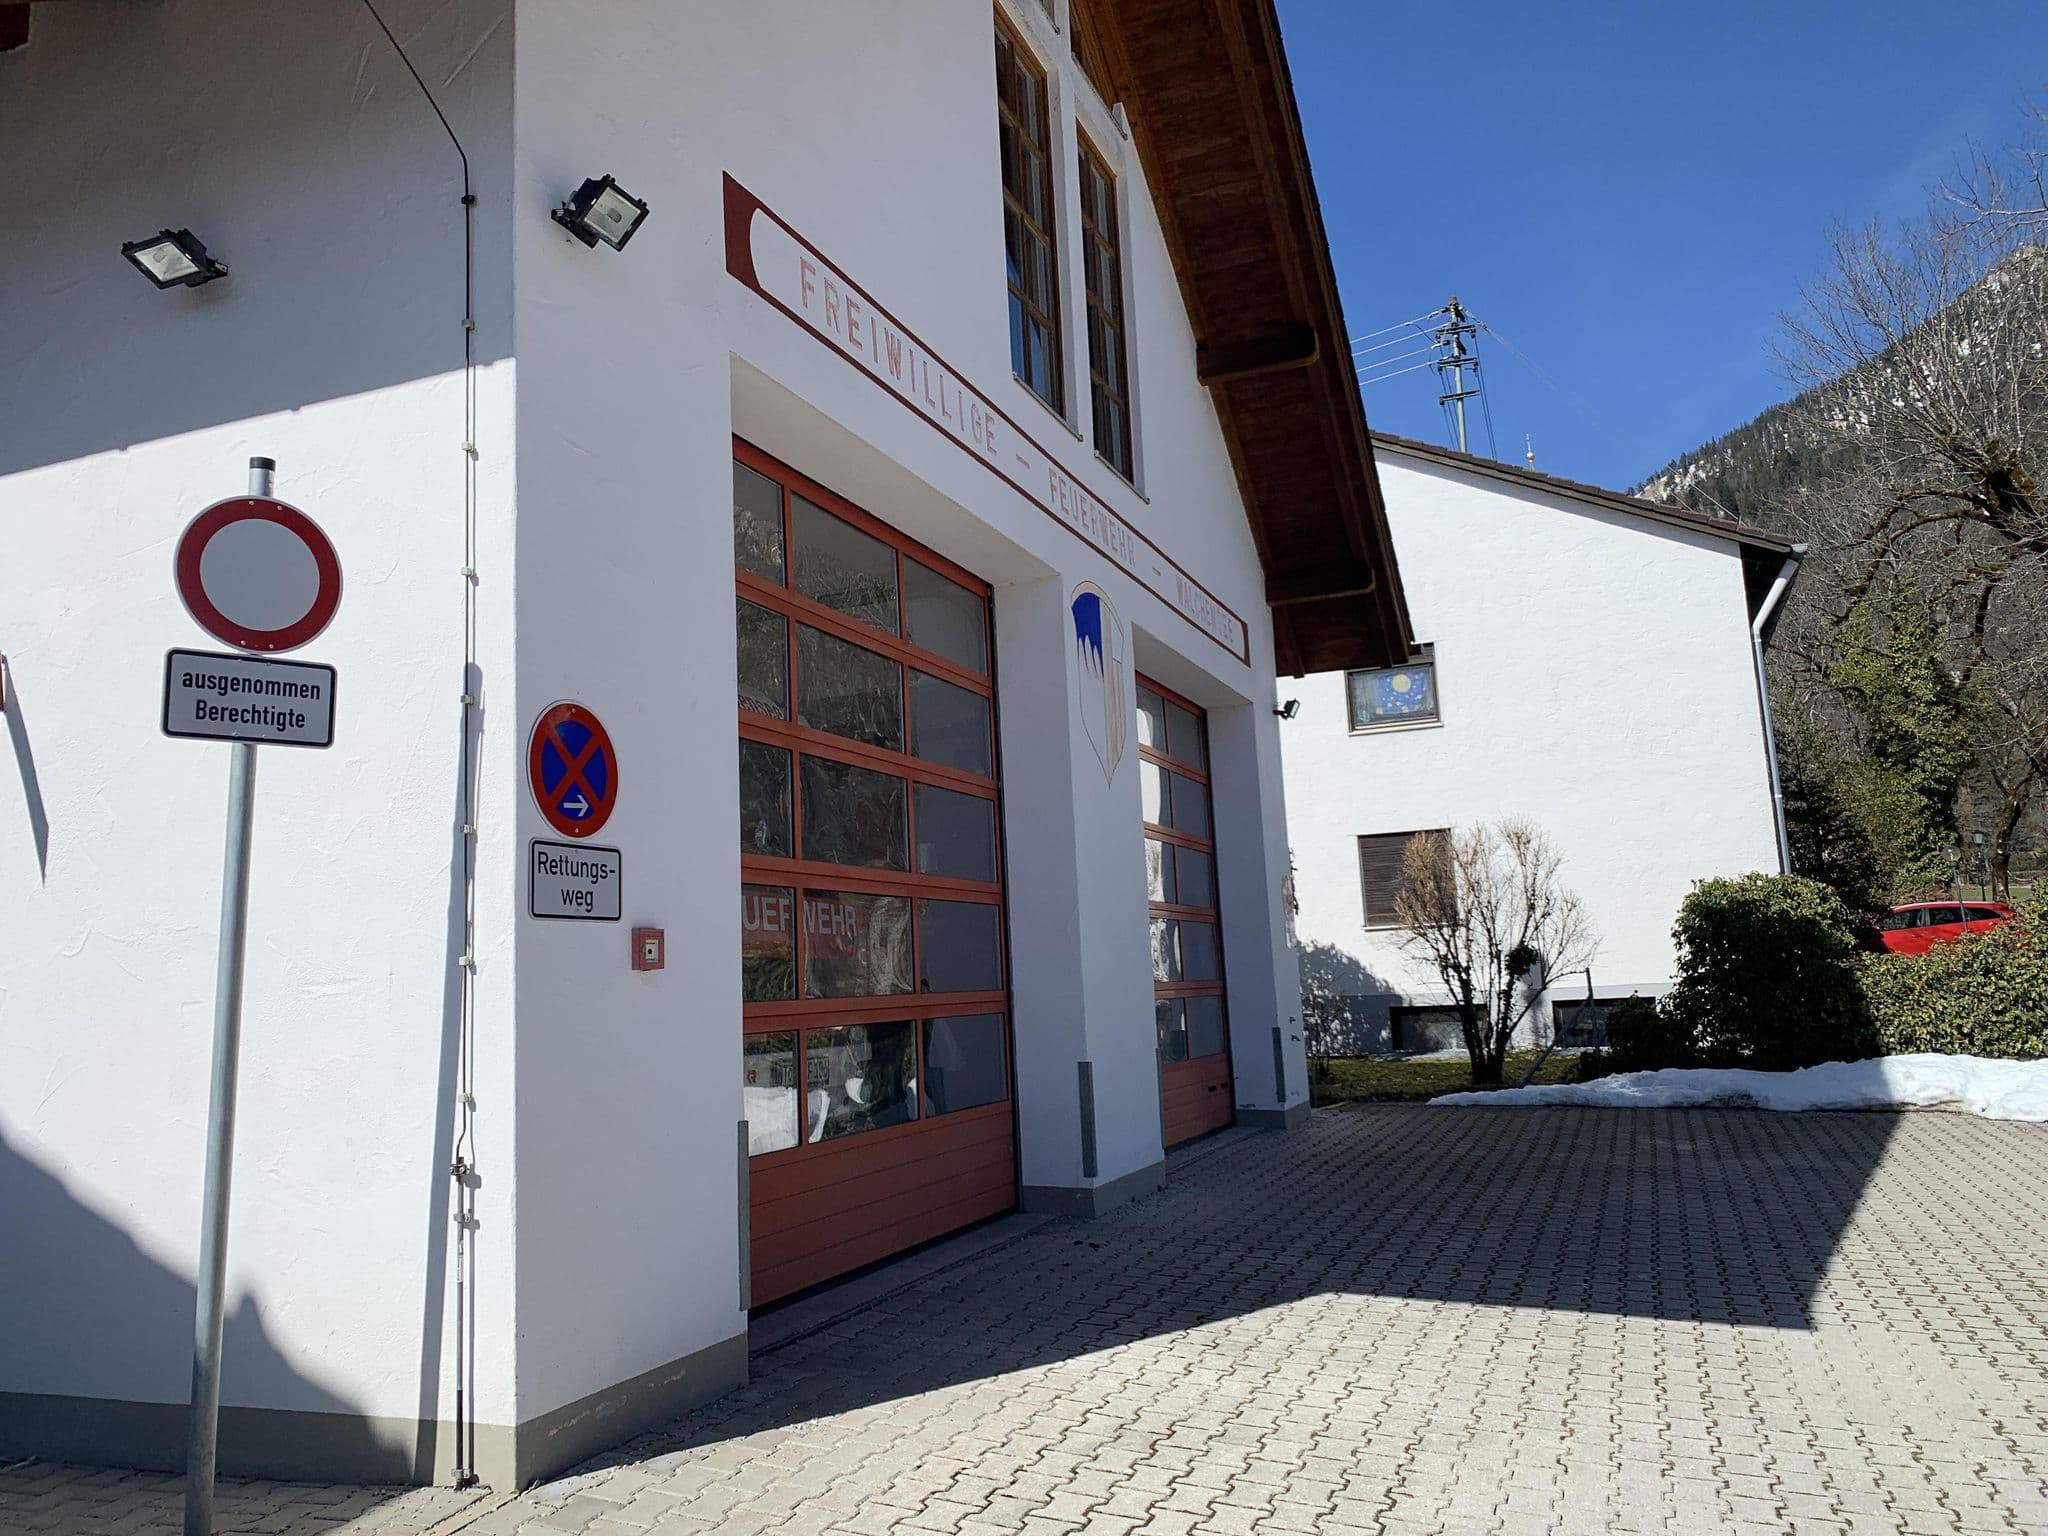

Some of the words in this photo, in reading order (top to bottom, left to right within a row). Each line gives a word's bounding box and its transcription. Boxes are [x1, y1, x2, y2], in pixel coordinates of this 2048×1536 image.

[800, 256, 998, 456] FREIWILLIGE
[1048, 466, 1136, 568] FEUERWEHR
[182, 671, 321, 700] ausgenommen
[195, 699, 306, 732] Berechtigte
[537, 851, 616, 884] Rettungs-
[560, 888, 594, 913] weg
